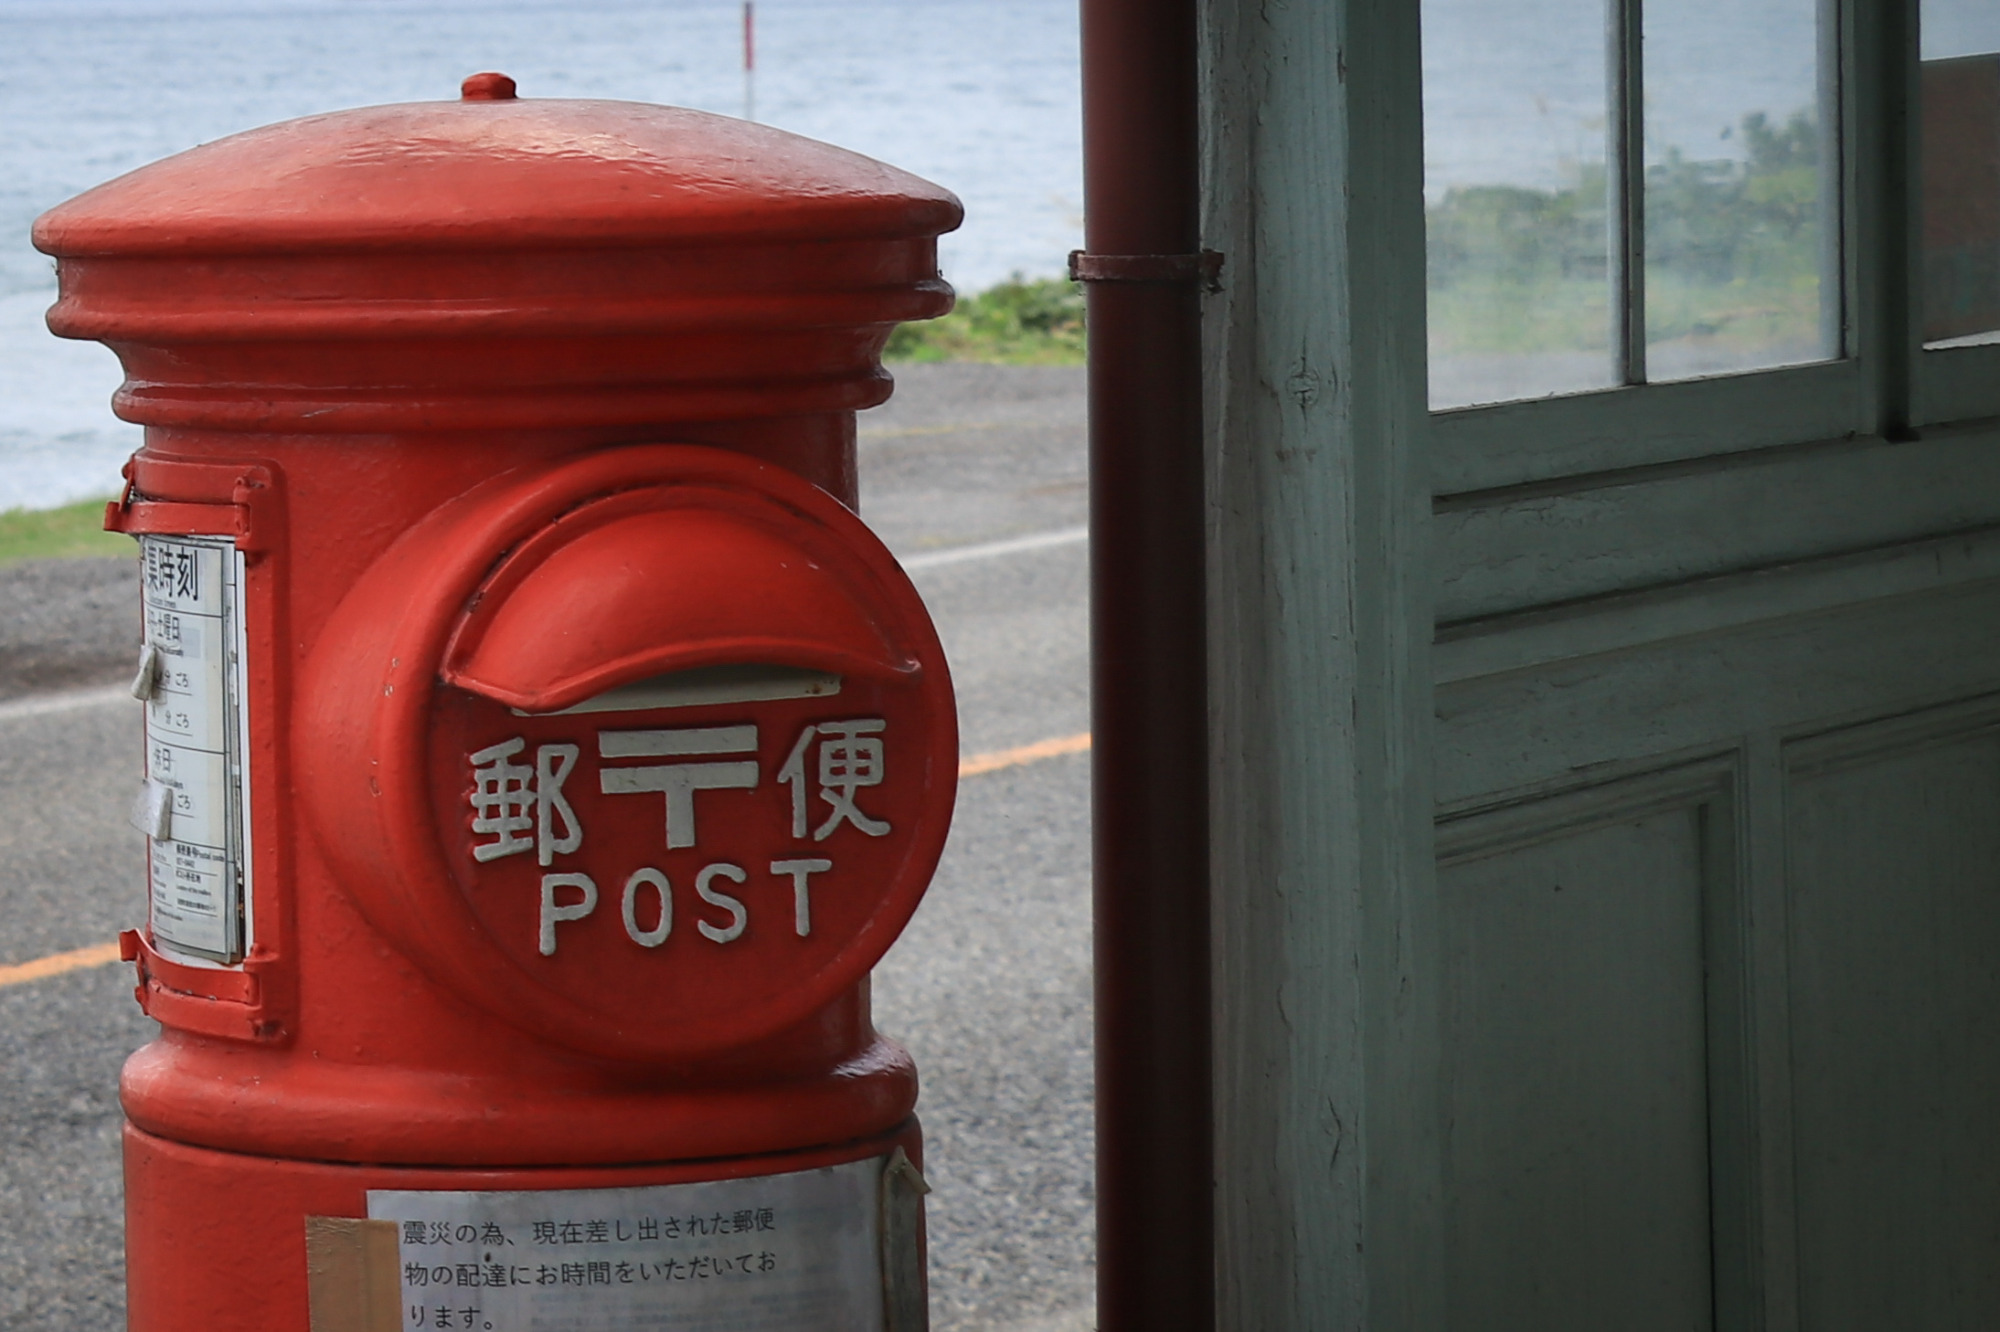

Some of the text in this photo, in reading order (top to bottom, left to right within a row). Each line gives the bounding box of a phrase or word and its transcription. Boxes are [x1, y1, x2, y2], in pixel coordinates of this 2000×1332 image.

[538, 858, 833, 956] POST
[402, 1206, 776, 1247] 震災の為、現在差し出された郵便
[404, 1250, 777, 1289] 物の配達にお時間をいただいてお
[409, 1303, 494, 1331] ります。
